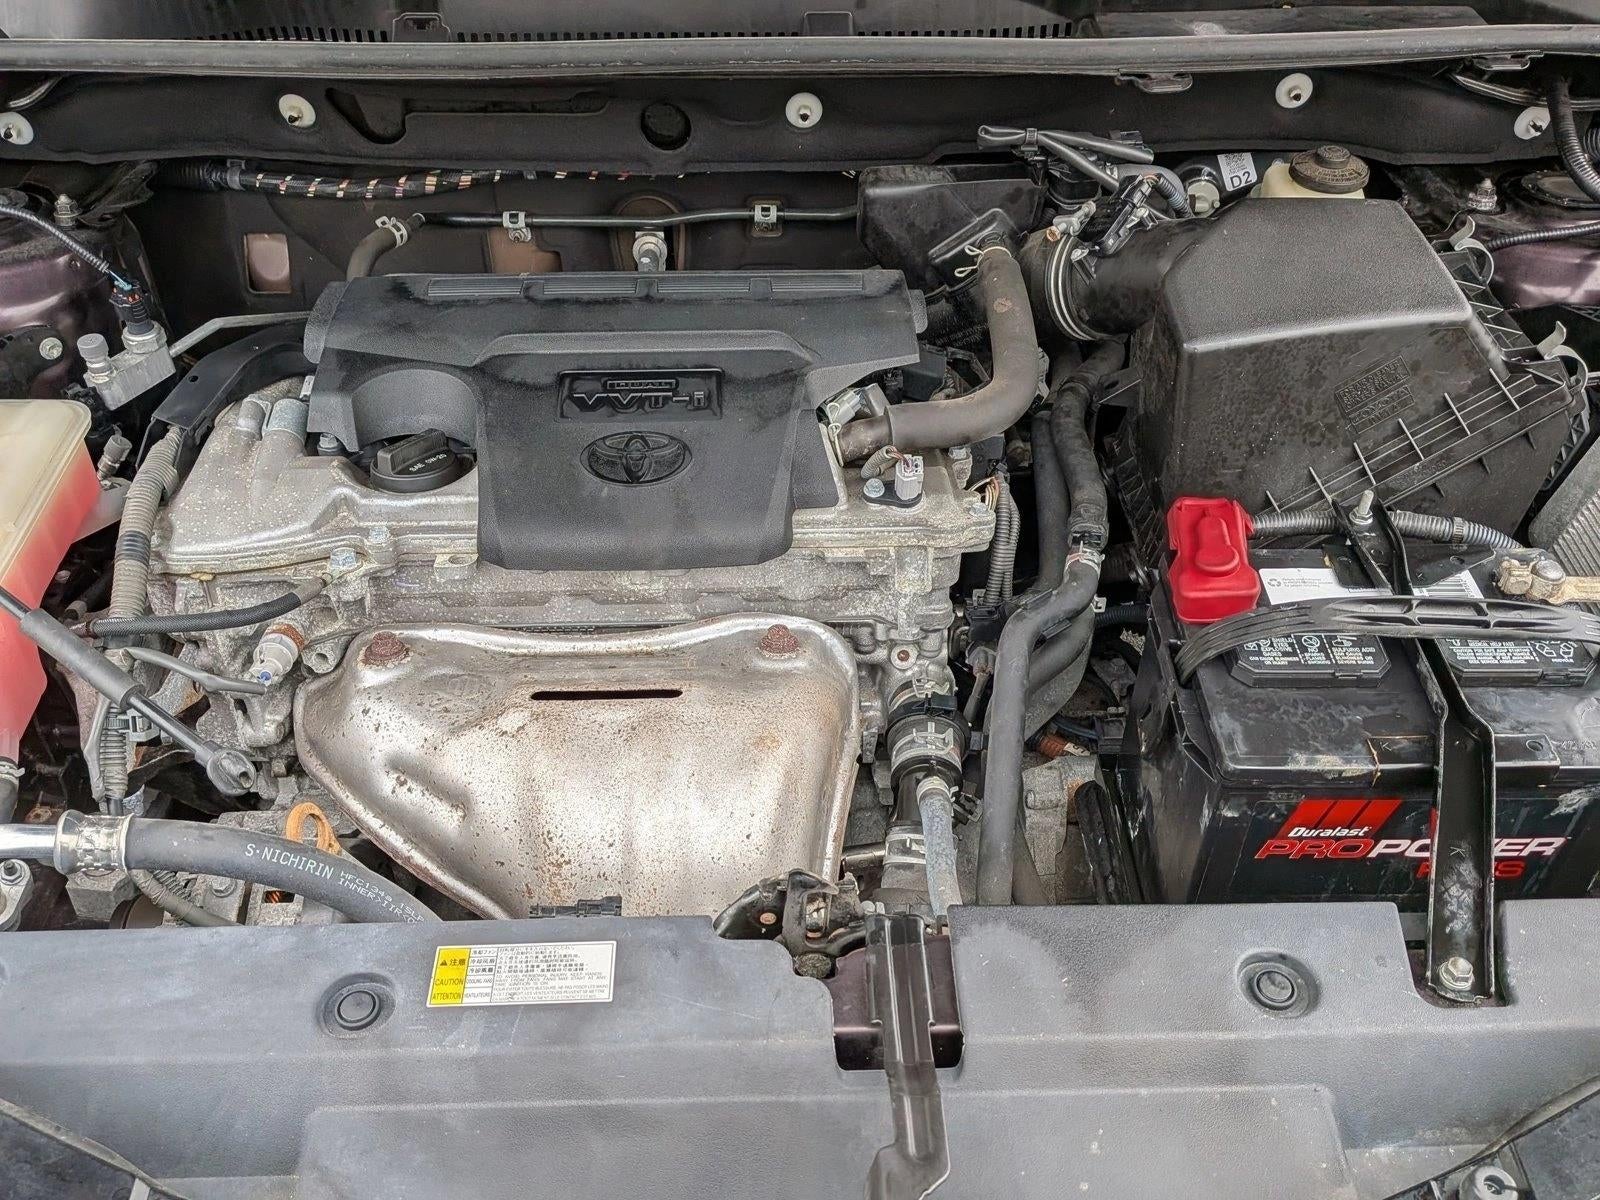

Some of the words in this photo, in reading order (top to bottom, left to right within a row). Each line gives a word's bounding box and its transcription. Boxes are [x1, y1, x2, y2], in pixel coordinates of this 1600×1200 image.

[1230, 170, 1252, 188] D2
[1288, 826, 1369, 838] Duralast
[1254, 837, 1568, 860] PROPOER
